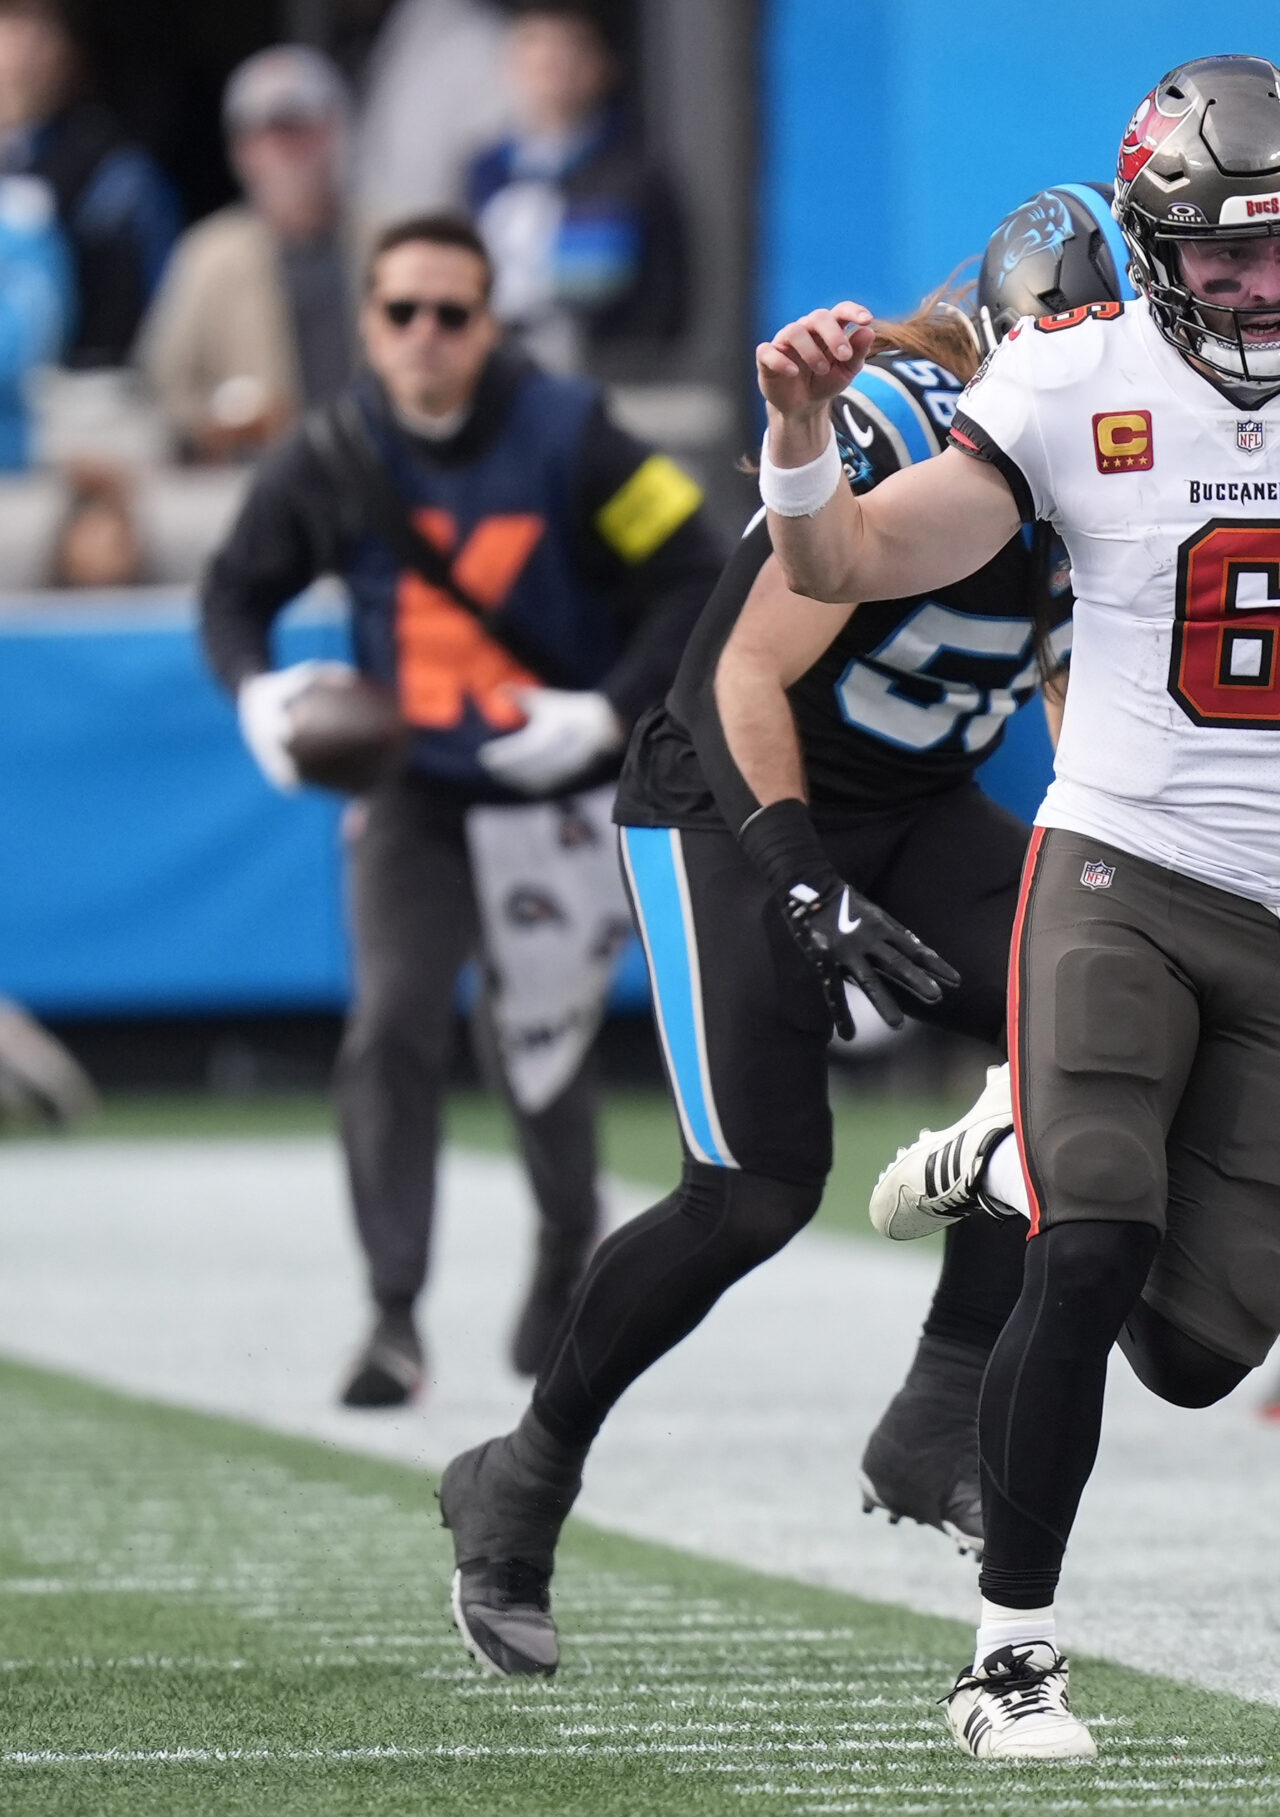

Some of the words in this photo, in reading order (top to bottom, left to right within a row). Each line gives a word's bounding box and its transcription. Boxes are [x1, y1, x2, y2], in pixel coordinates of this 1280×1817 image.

[1246, 197, 1280, 217] BUCS
[1167, 214, 1202, 223] OAKLEY
[1096, 413, 1148, 458] C
[1239, 433, 1262, 448] NFL
[396, 506, 546, 734] K
[1086, 872, 1108, 885] NFL
